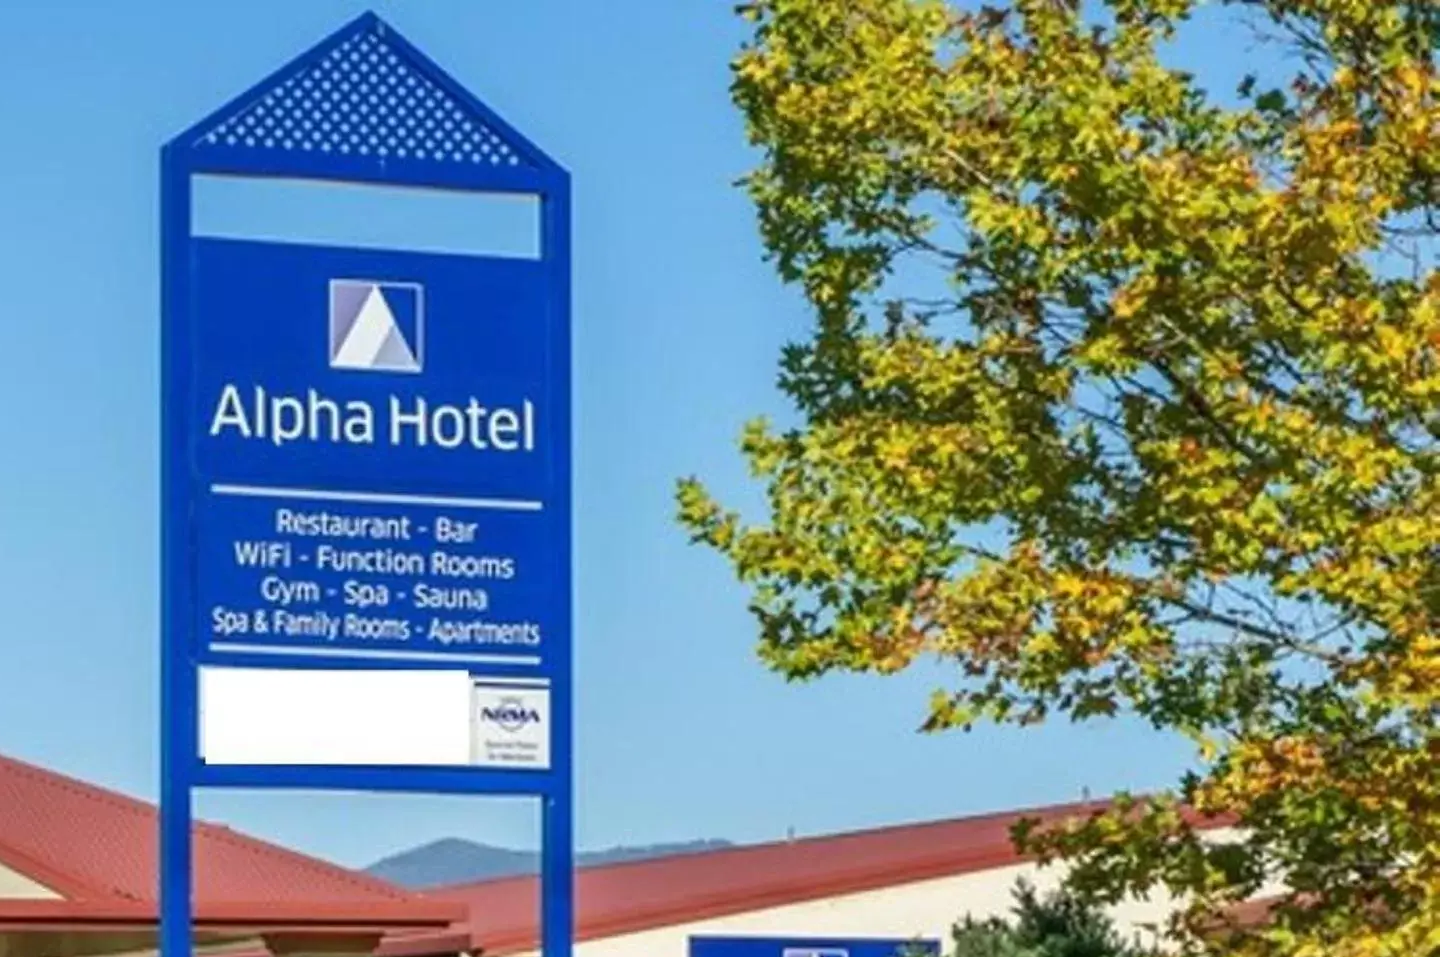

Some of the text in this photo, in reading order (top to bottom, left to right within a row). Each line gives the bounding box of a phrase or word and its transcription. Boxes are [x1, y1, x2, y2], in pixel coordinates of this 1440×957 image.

[210, 384, 535, 452] Alpha Hotel
[275, 508, 411, 540] Restaurant
[435, 516, 479, 543] Bar
[234, 540, 292, 568] WiFi
[316, 545, 424, 575] Function
[430, 552, 514, 579] Rooms
[260, 576, 320, 604] Gym
[343, 580, 389, 607] Spa
[413, 583, 488, 611] Sauna
[212, 606, 248, 637] Spa
[253, 610, 267, 632] &
[273, 610, 340, 640] Family
[344, 613, 410, 639] Rooms
[428, 618, 541, 646] Apartments
